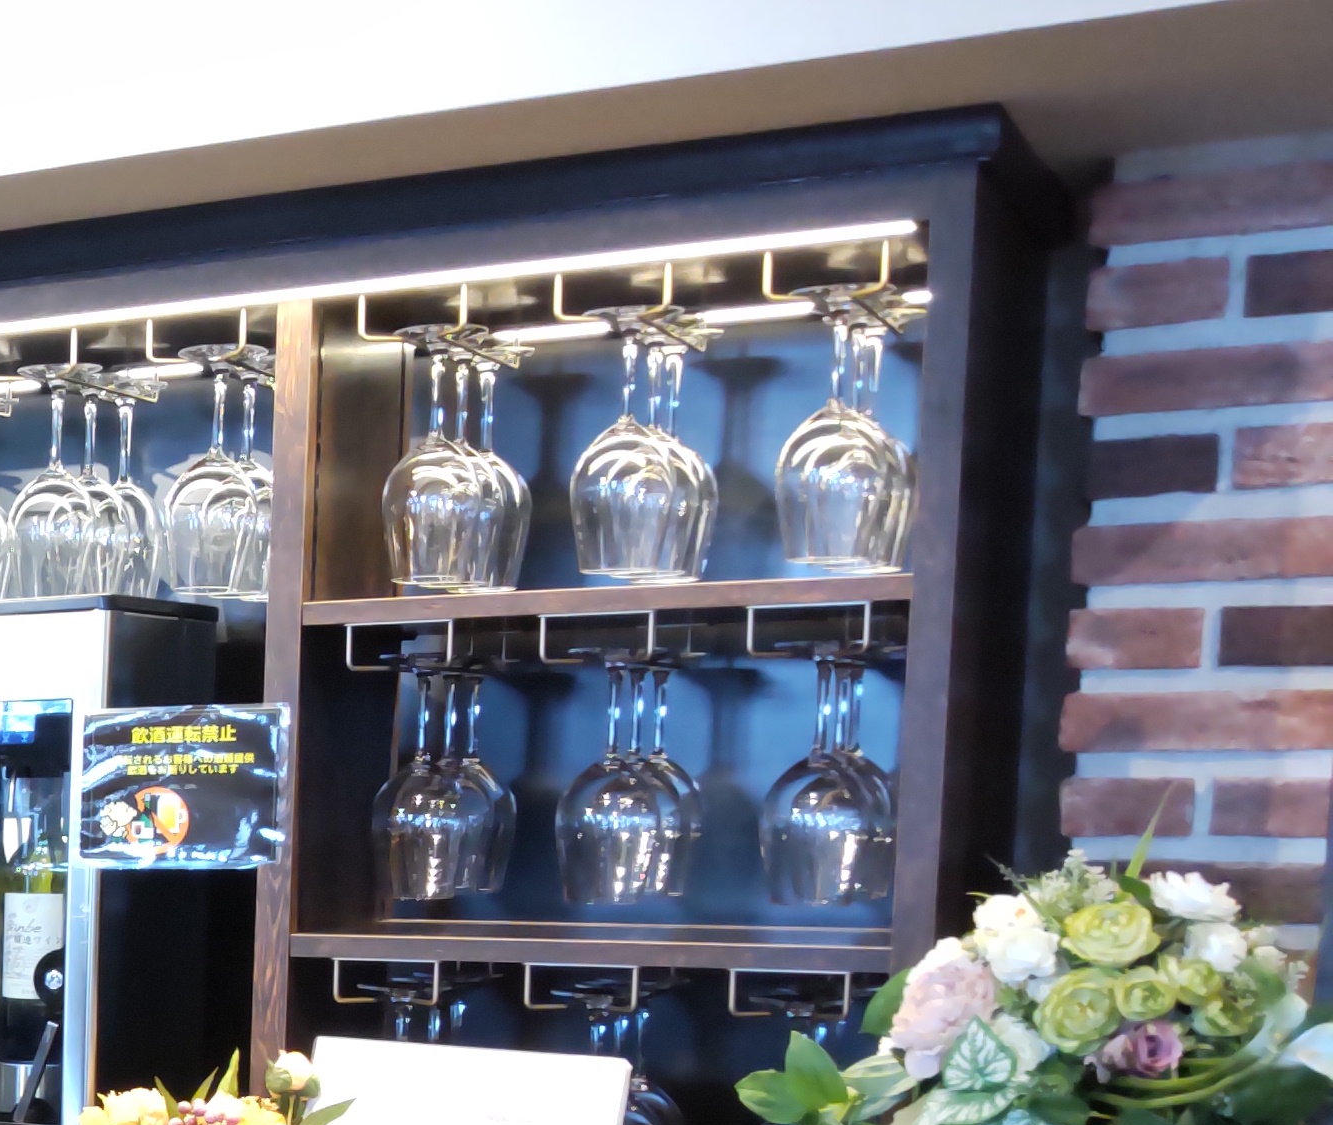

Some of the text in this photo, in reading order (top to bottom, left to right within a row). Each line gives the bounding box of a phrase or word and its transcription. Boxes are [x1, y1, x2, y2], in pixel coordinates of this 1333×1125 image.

[131, 725, 237, 744] 飲酒運転禁止
